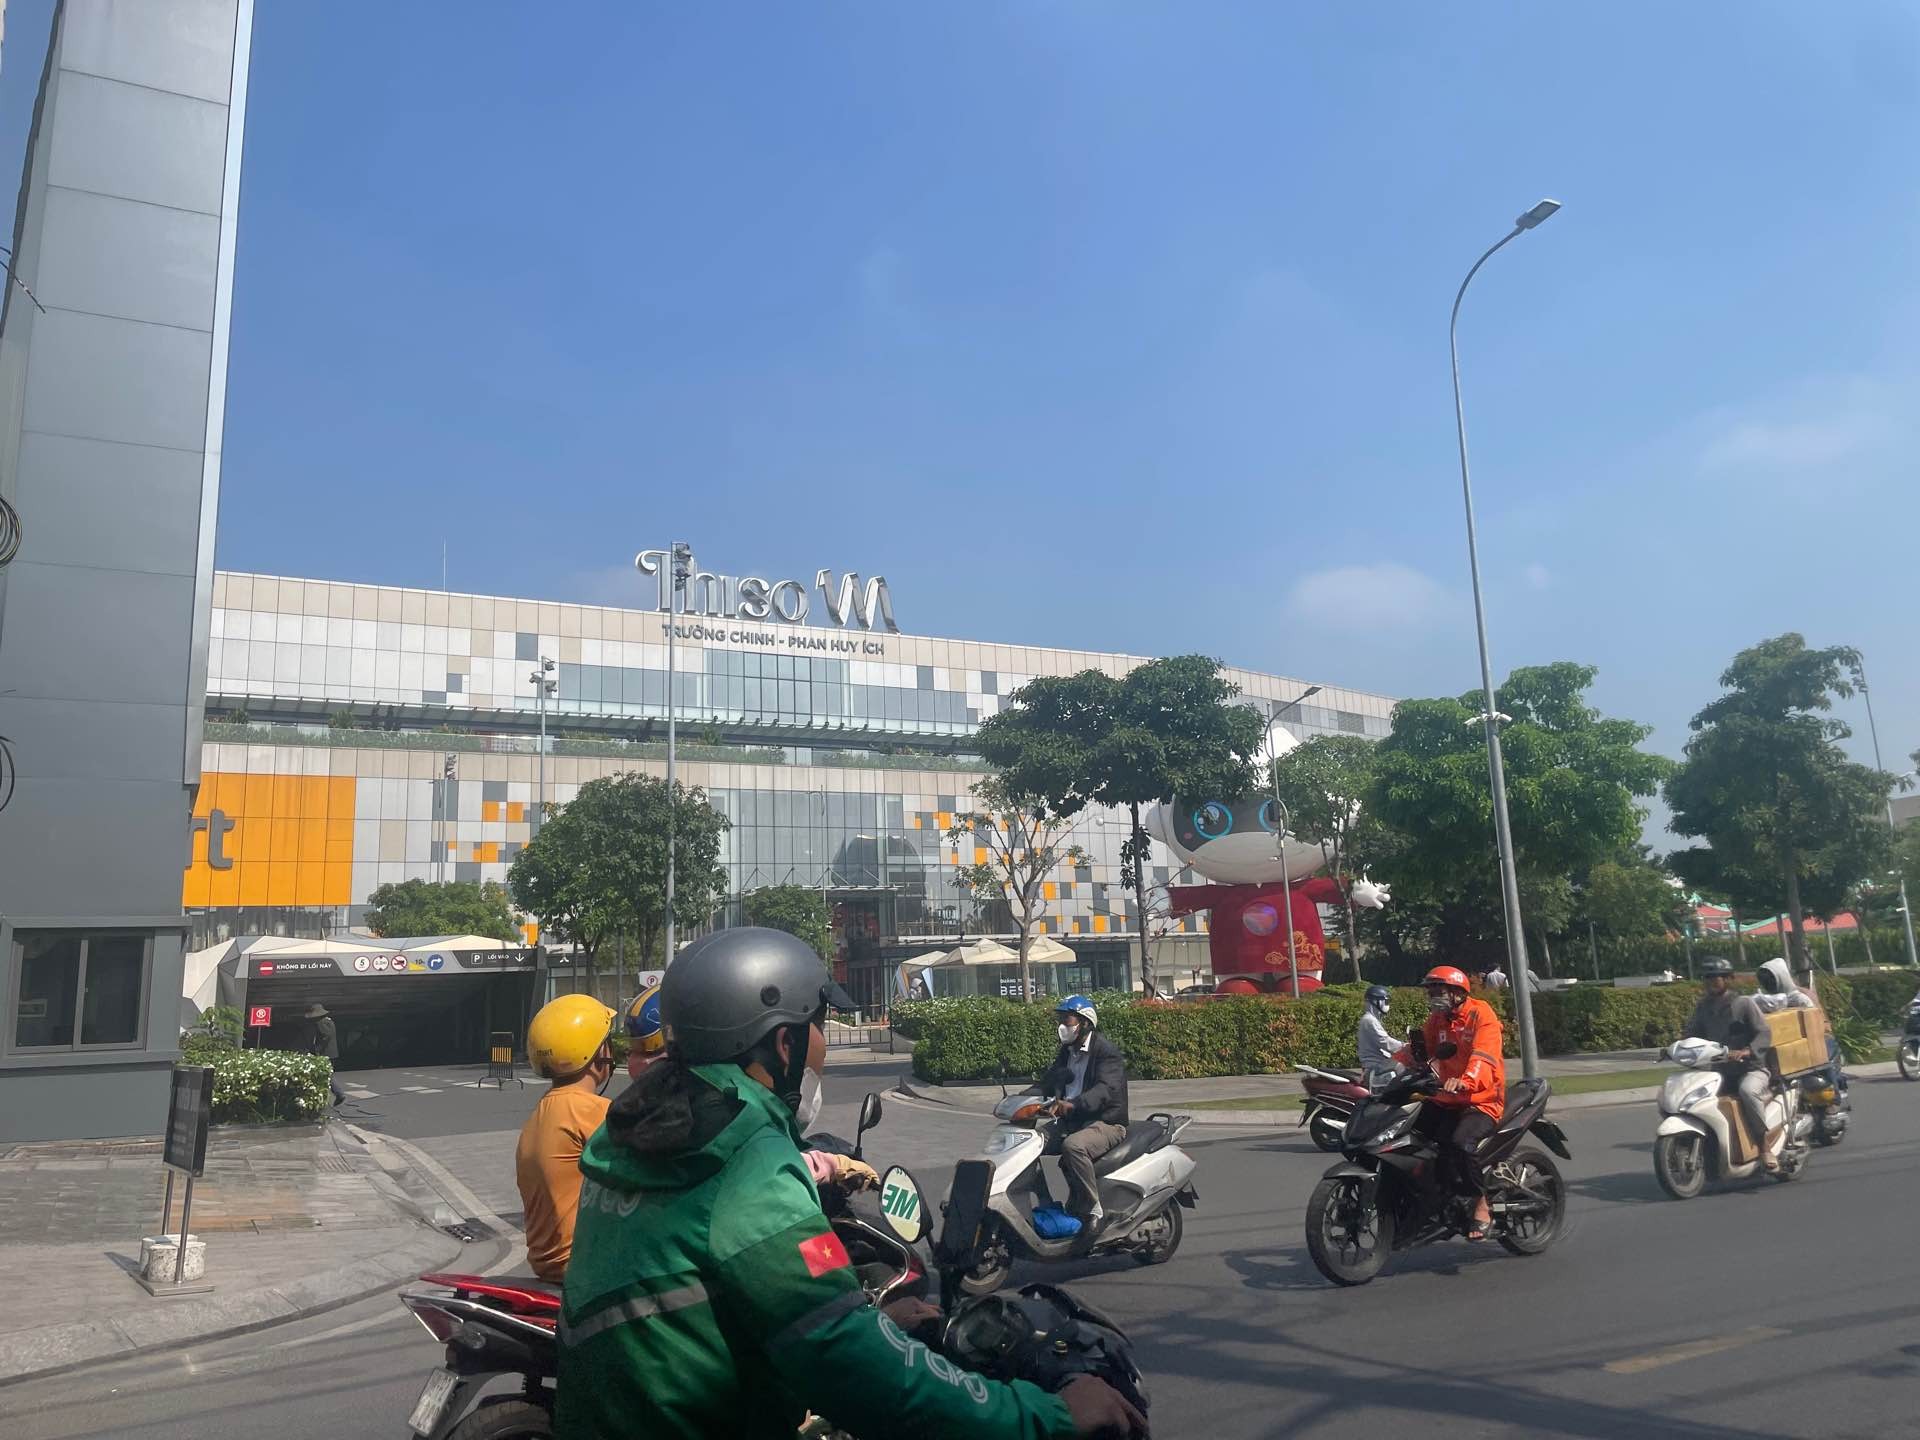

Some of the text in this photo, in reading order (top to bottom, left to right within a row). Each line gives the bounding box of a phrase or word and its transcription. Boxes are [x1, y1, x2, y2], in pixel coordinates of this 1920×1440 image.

[730, 630, 775, 646] CHINH
[788, 636, 827, 650] PHAN
[830, 639, 859, 653] HUY
[862, 639, 885, 656] ÍCH
